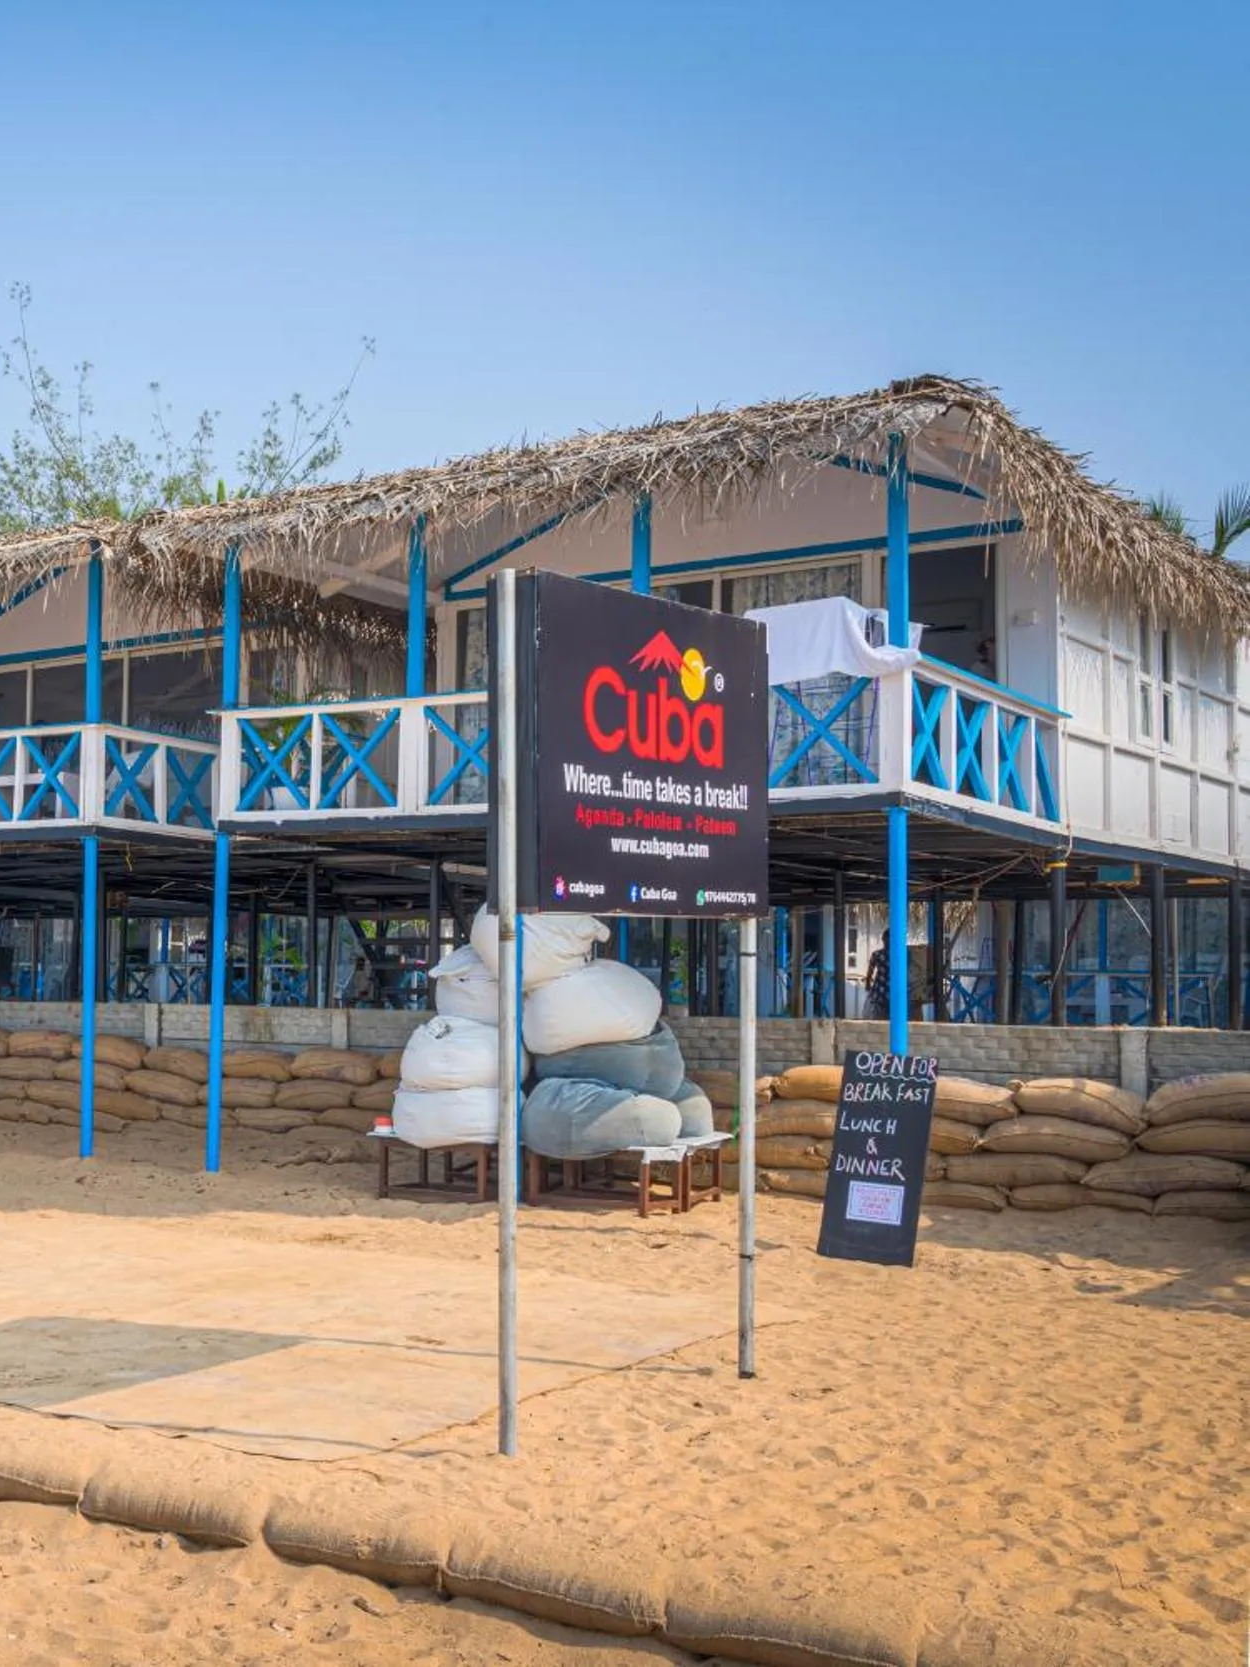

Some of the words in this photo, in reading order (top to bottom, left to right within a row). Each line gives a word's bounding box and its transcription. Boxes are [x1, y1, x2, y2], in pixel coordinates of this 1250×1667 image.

[583, 666, 725, 769] Cuba
[655, 776, 691, 806] takes
[694, 786, 702, 806] a
[705, 781, 748, 810] break!!
[611, 836, 710, 860] www.cubagoa.com
[569, 881, 605, 898] cubagoa
[640, 886, 660, 900] Cuba
[661, 888, 678, 901] Goa
[856, 1051, 906, 1074] OPEN
[910, 1056, 938, 1081] FOR
[844, 1082, 893, 1102] BREAK
[839, 1112, 898, 1135] LUNCH
[866, 1137, 879, 1155] &
[835, 1154, 906, 1181] DINNER
